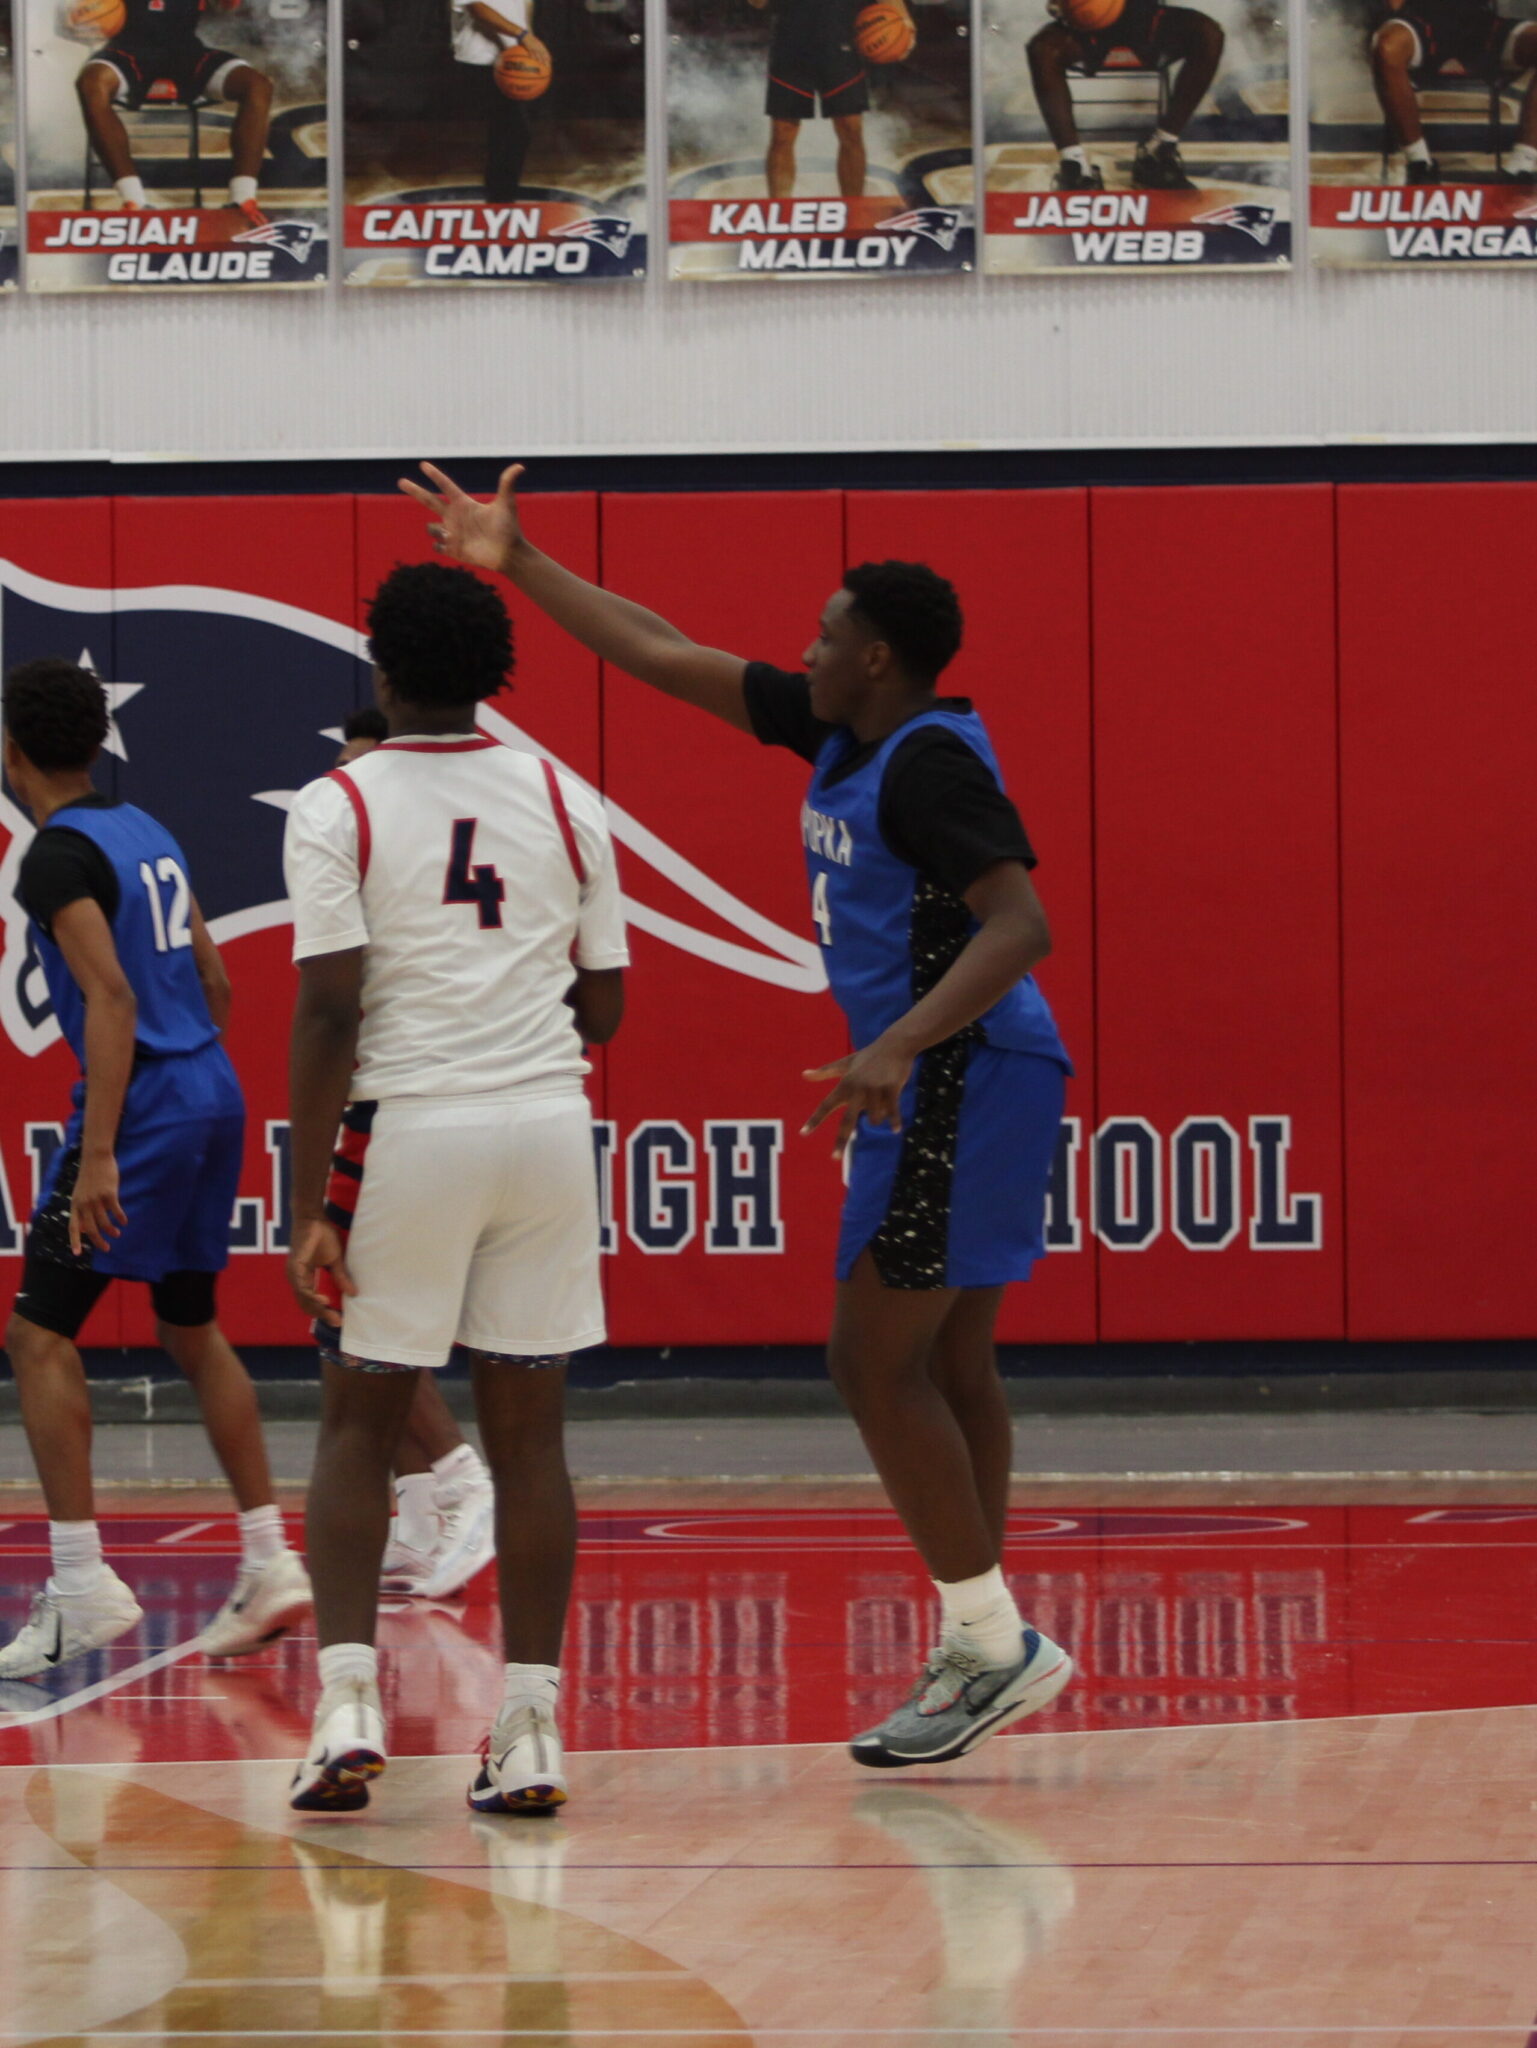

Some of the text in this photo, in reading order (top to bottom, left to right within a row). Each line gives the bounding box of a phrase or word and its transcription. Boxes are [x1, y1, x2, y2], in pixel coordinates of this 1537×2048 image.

[708, 201, 847, 234] KALEB
[1013, 195, 1148, 227] JASON
[1337, 189, 1483, 222] JULIAN
[45, 216, 198, 247] JOSIAH
[363, 208, 541, 241] CAITLYN
[738, 236, 918, 269] MALLOY
[1071, 230, 1205, 262] WEBB
[1386, 225, 1537, 258] VARGA
[108, 252, 274, 281] GLAUDE
[425, 242, 590, 275] CAMPO
[442, 817, 505, 930] 4
[139, 856, 193, 952] 12
